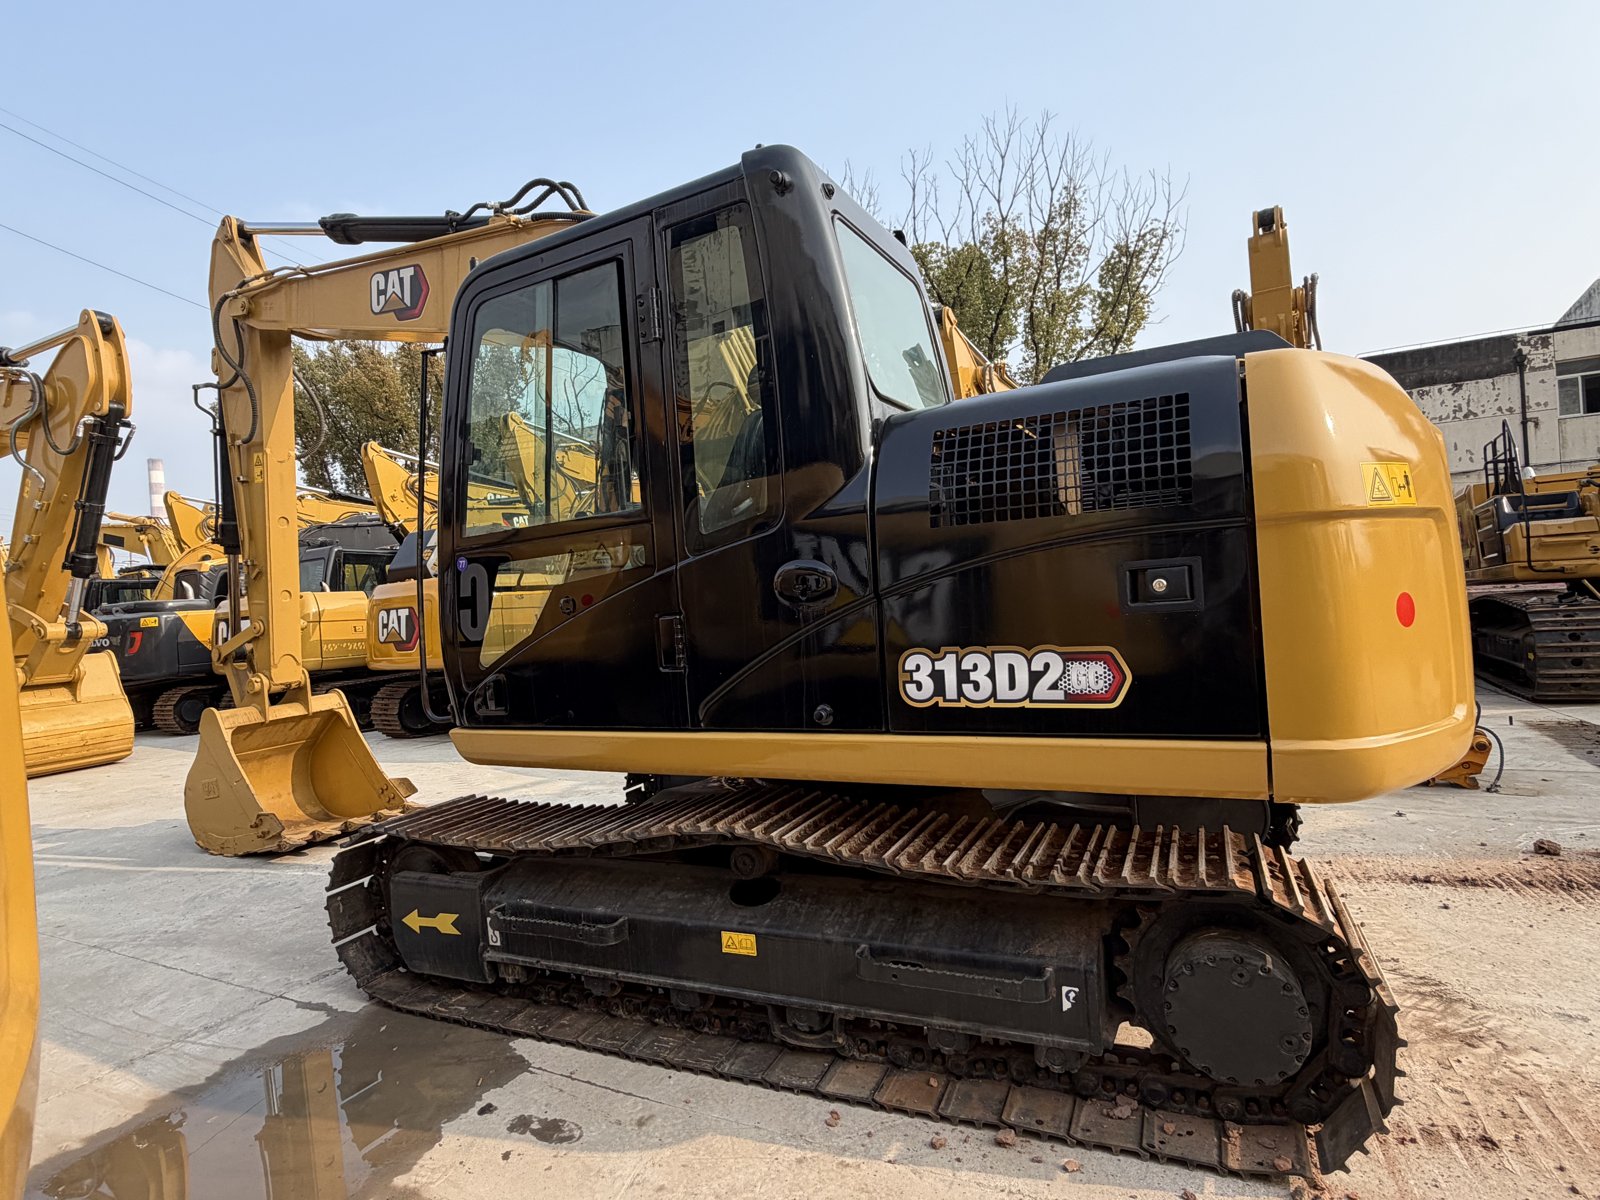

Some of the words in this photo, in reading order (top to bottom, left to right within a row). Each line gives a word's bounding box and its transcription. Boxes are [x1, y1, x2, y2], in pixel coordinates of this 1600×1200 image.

[371, 266, 415, 313] CAT
[513, 515, 529, 528] CAT
[458, 560, 466, 569] 77
[378, 608, 410, 643] CAT
[904, 651, 1066, 701] 313D2
[1070, 664, 1104, 691] GC
